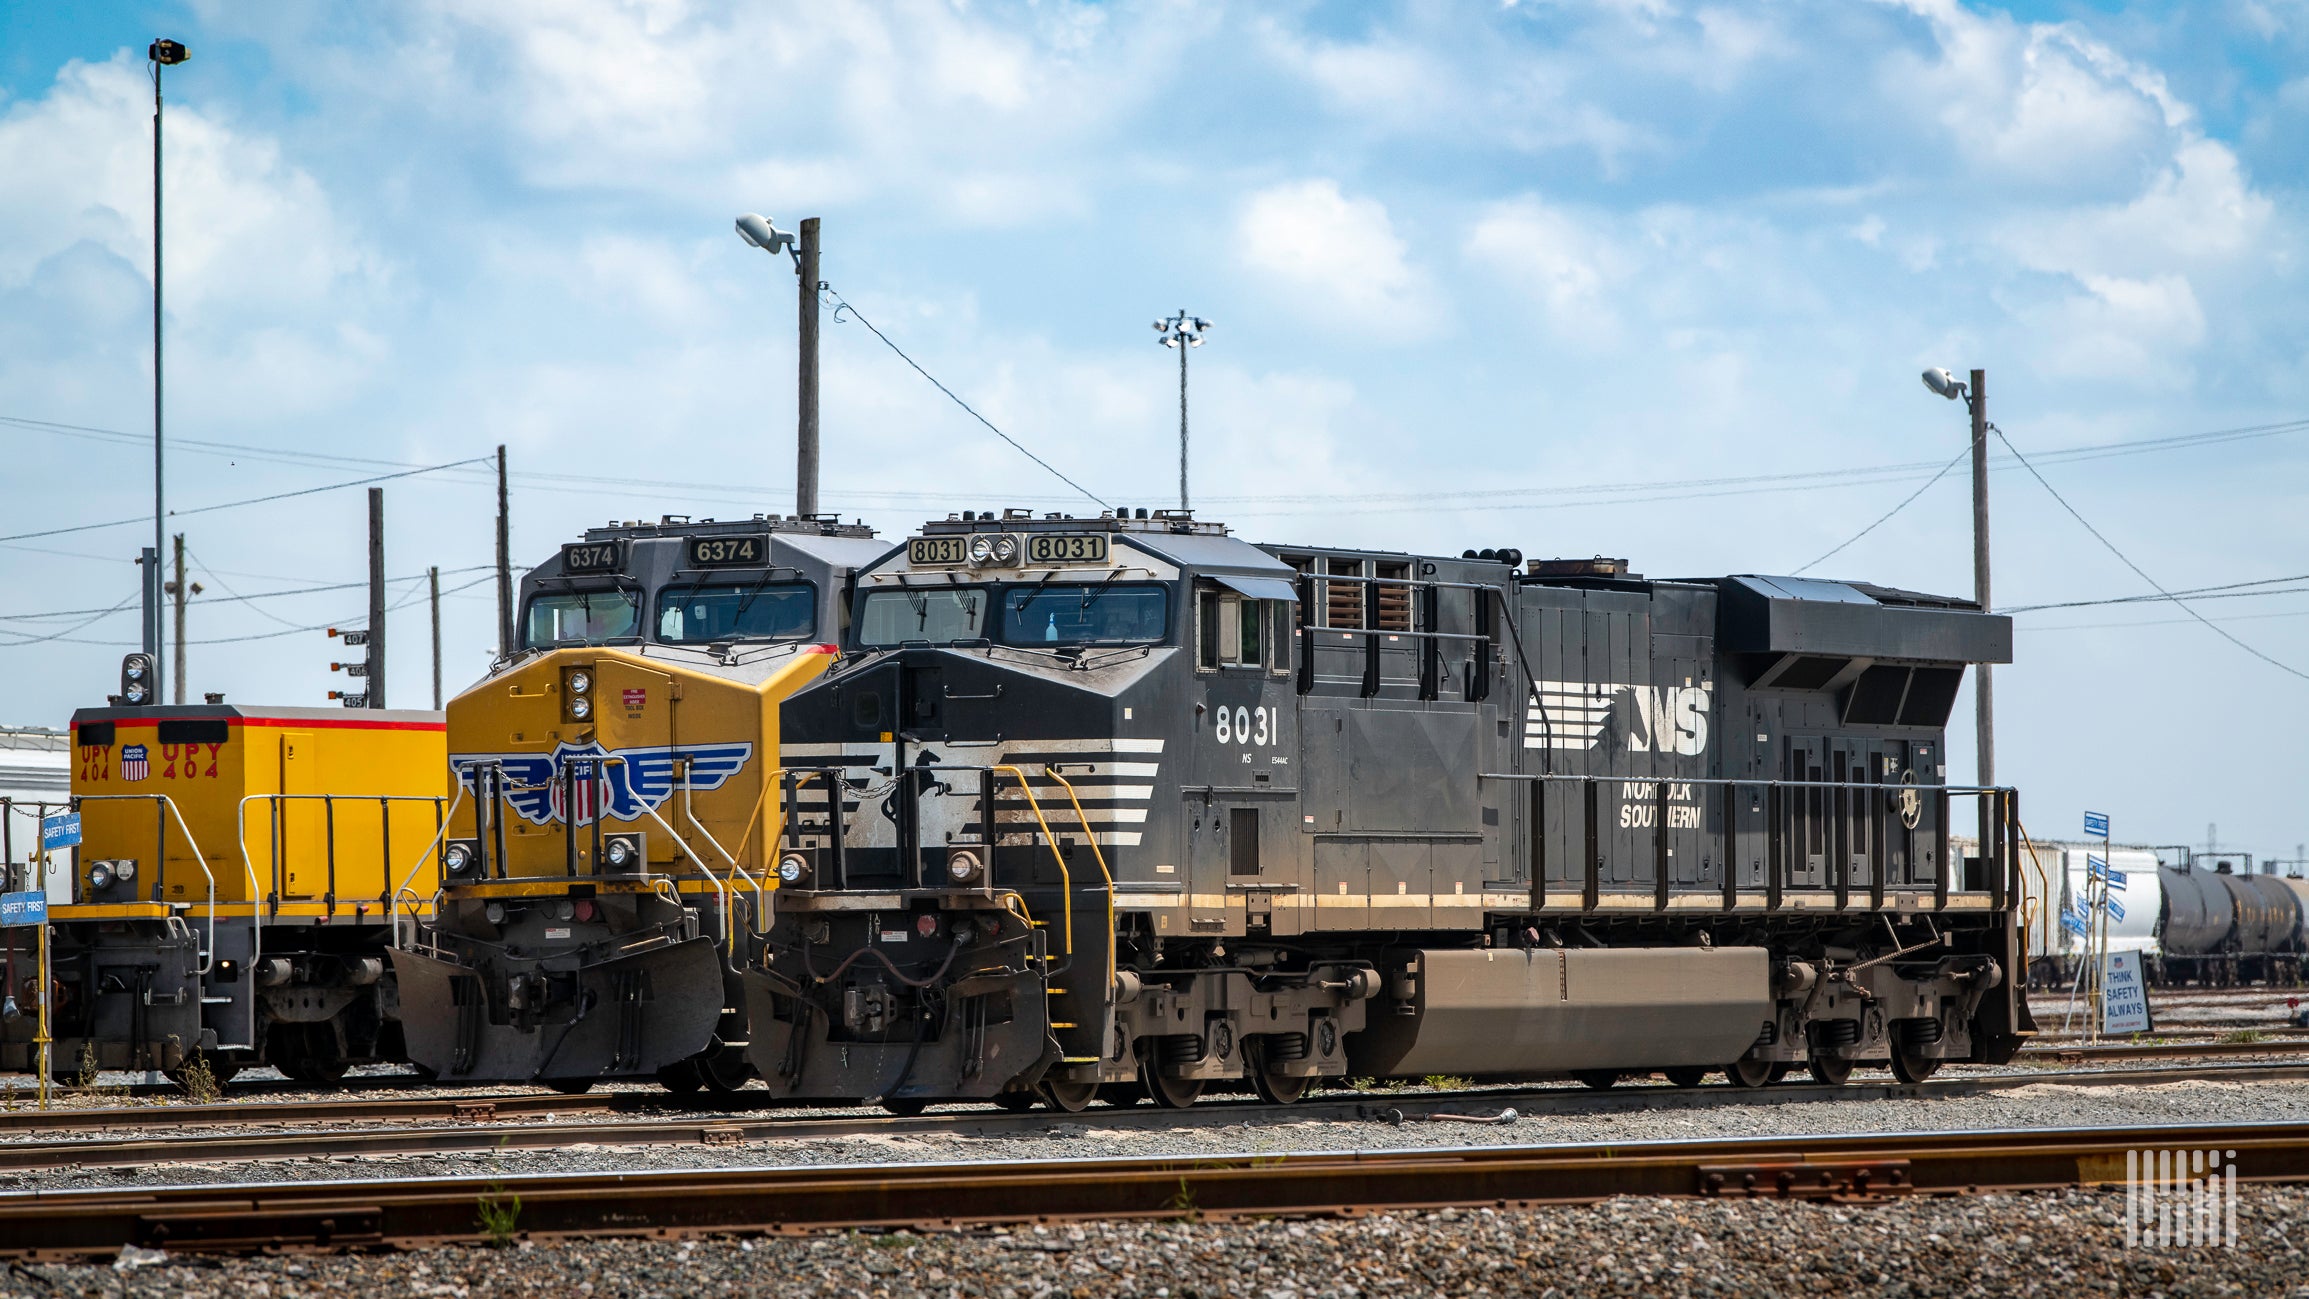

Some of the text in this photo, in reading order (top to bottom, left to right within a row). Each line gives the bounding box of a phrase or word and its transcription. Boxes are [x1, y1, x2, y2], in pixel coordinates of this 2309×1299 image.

[570, 546, 613, 567] 6374
[697, 540, 754, 561] 6374
[915, 541, 961, 561] 8031
[1037, 538, 1098, 558] 8031
[346, 635, 363, 644] 407
[345, 698, 362, 708] 405
[1216, 705, 1277, 746] 8031
[82, 746, 111, 763] UPY
[162, 743, 222, 762] UPY
[1241, 753, 1252, 763] NS
[80, 764, 109, 782] 404
[163, 760, 219, 779] 404
[1623, 776, 1692, 801] NOROLK
[44, 822, 80, 838] SAFETY FIRST
[2, 901, 44, 914] SAFETY FIRST
[2107, 970, 2133, 984] THINK
[2106, 986, 2138, 1001] SAFETY
[2107, 1003, 2143, 1018] ALWAYS
